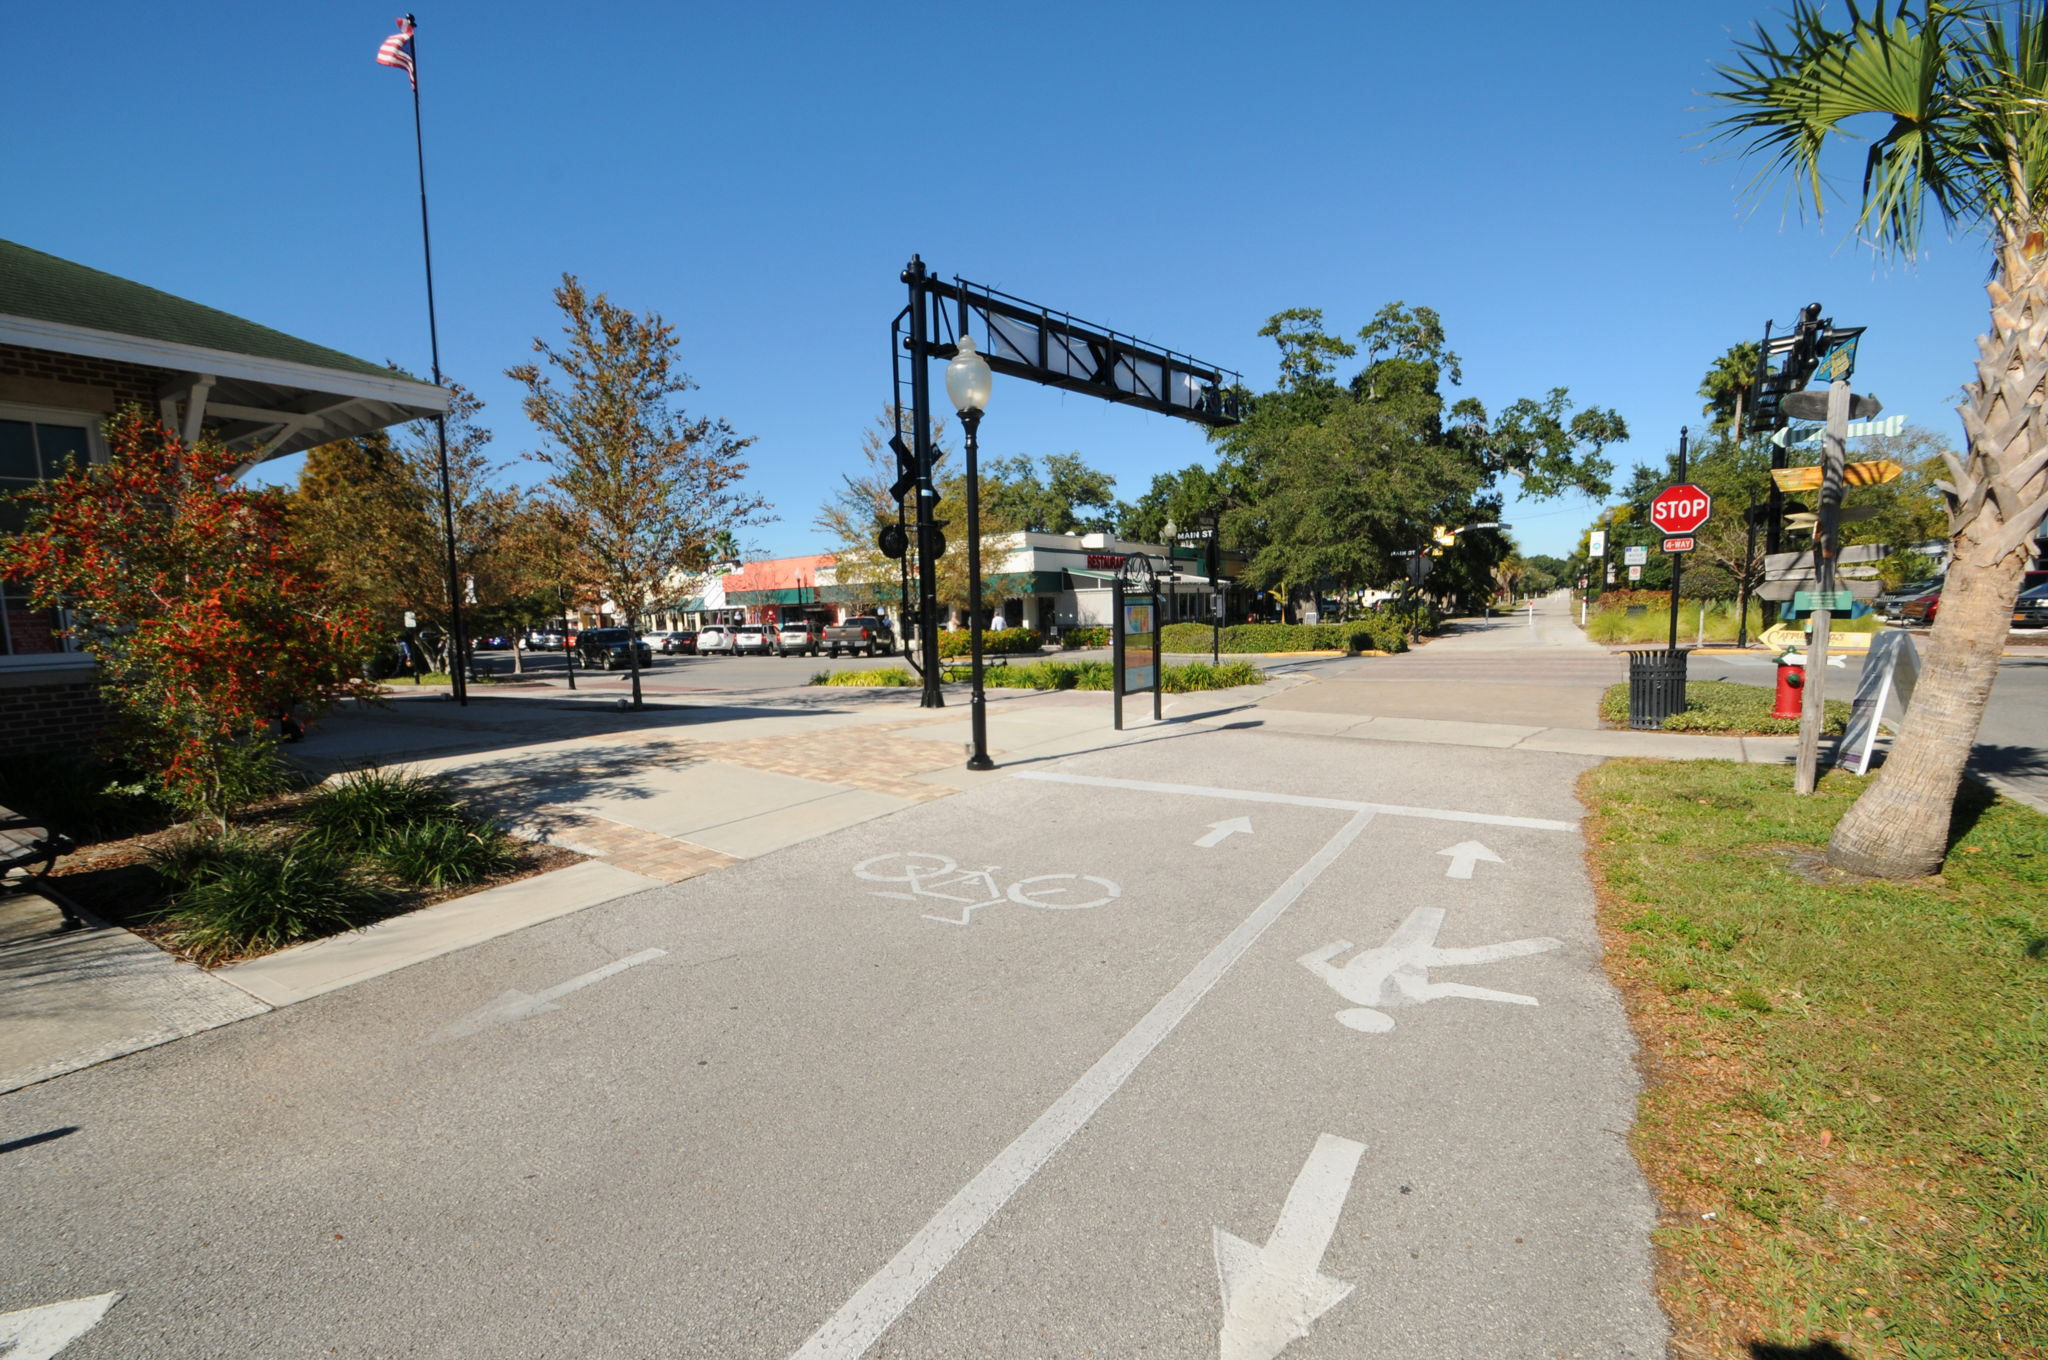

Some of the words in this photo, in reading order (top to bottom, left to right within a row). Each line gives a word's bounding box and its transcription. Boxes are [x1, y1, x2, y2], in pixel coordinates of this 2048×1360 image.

[1655, 499, 1706, 520] STOP
[1177, 531, 1200, 540] MAIN
[1201, 529, 1213, 538] ST
